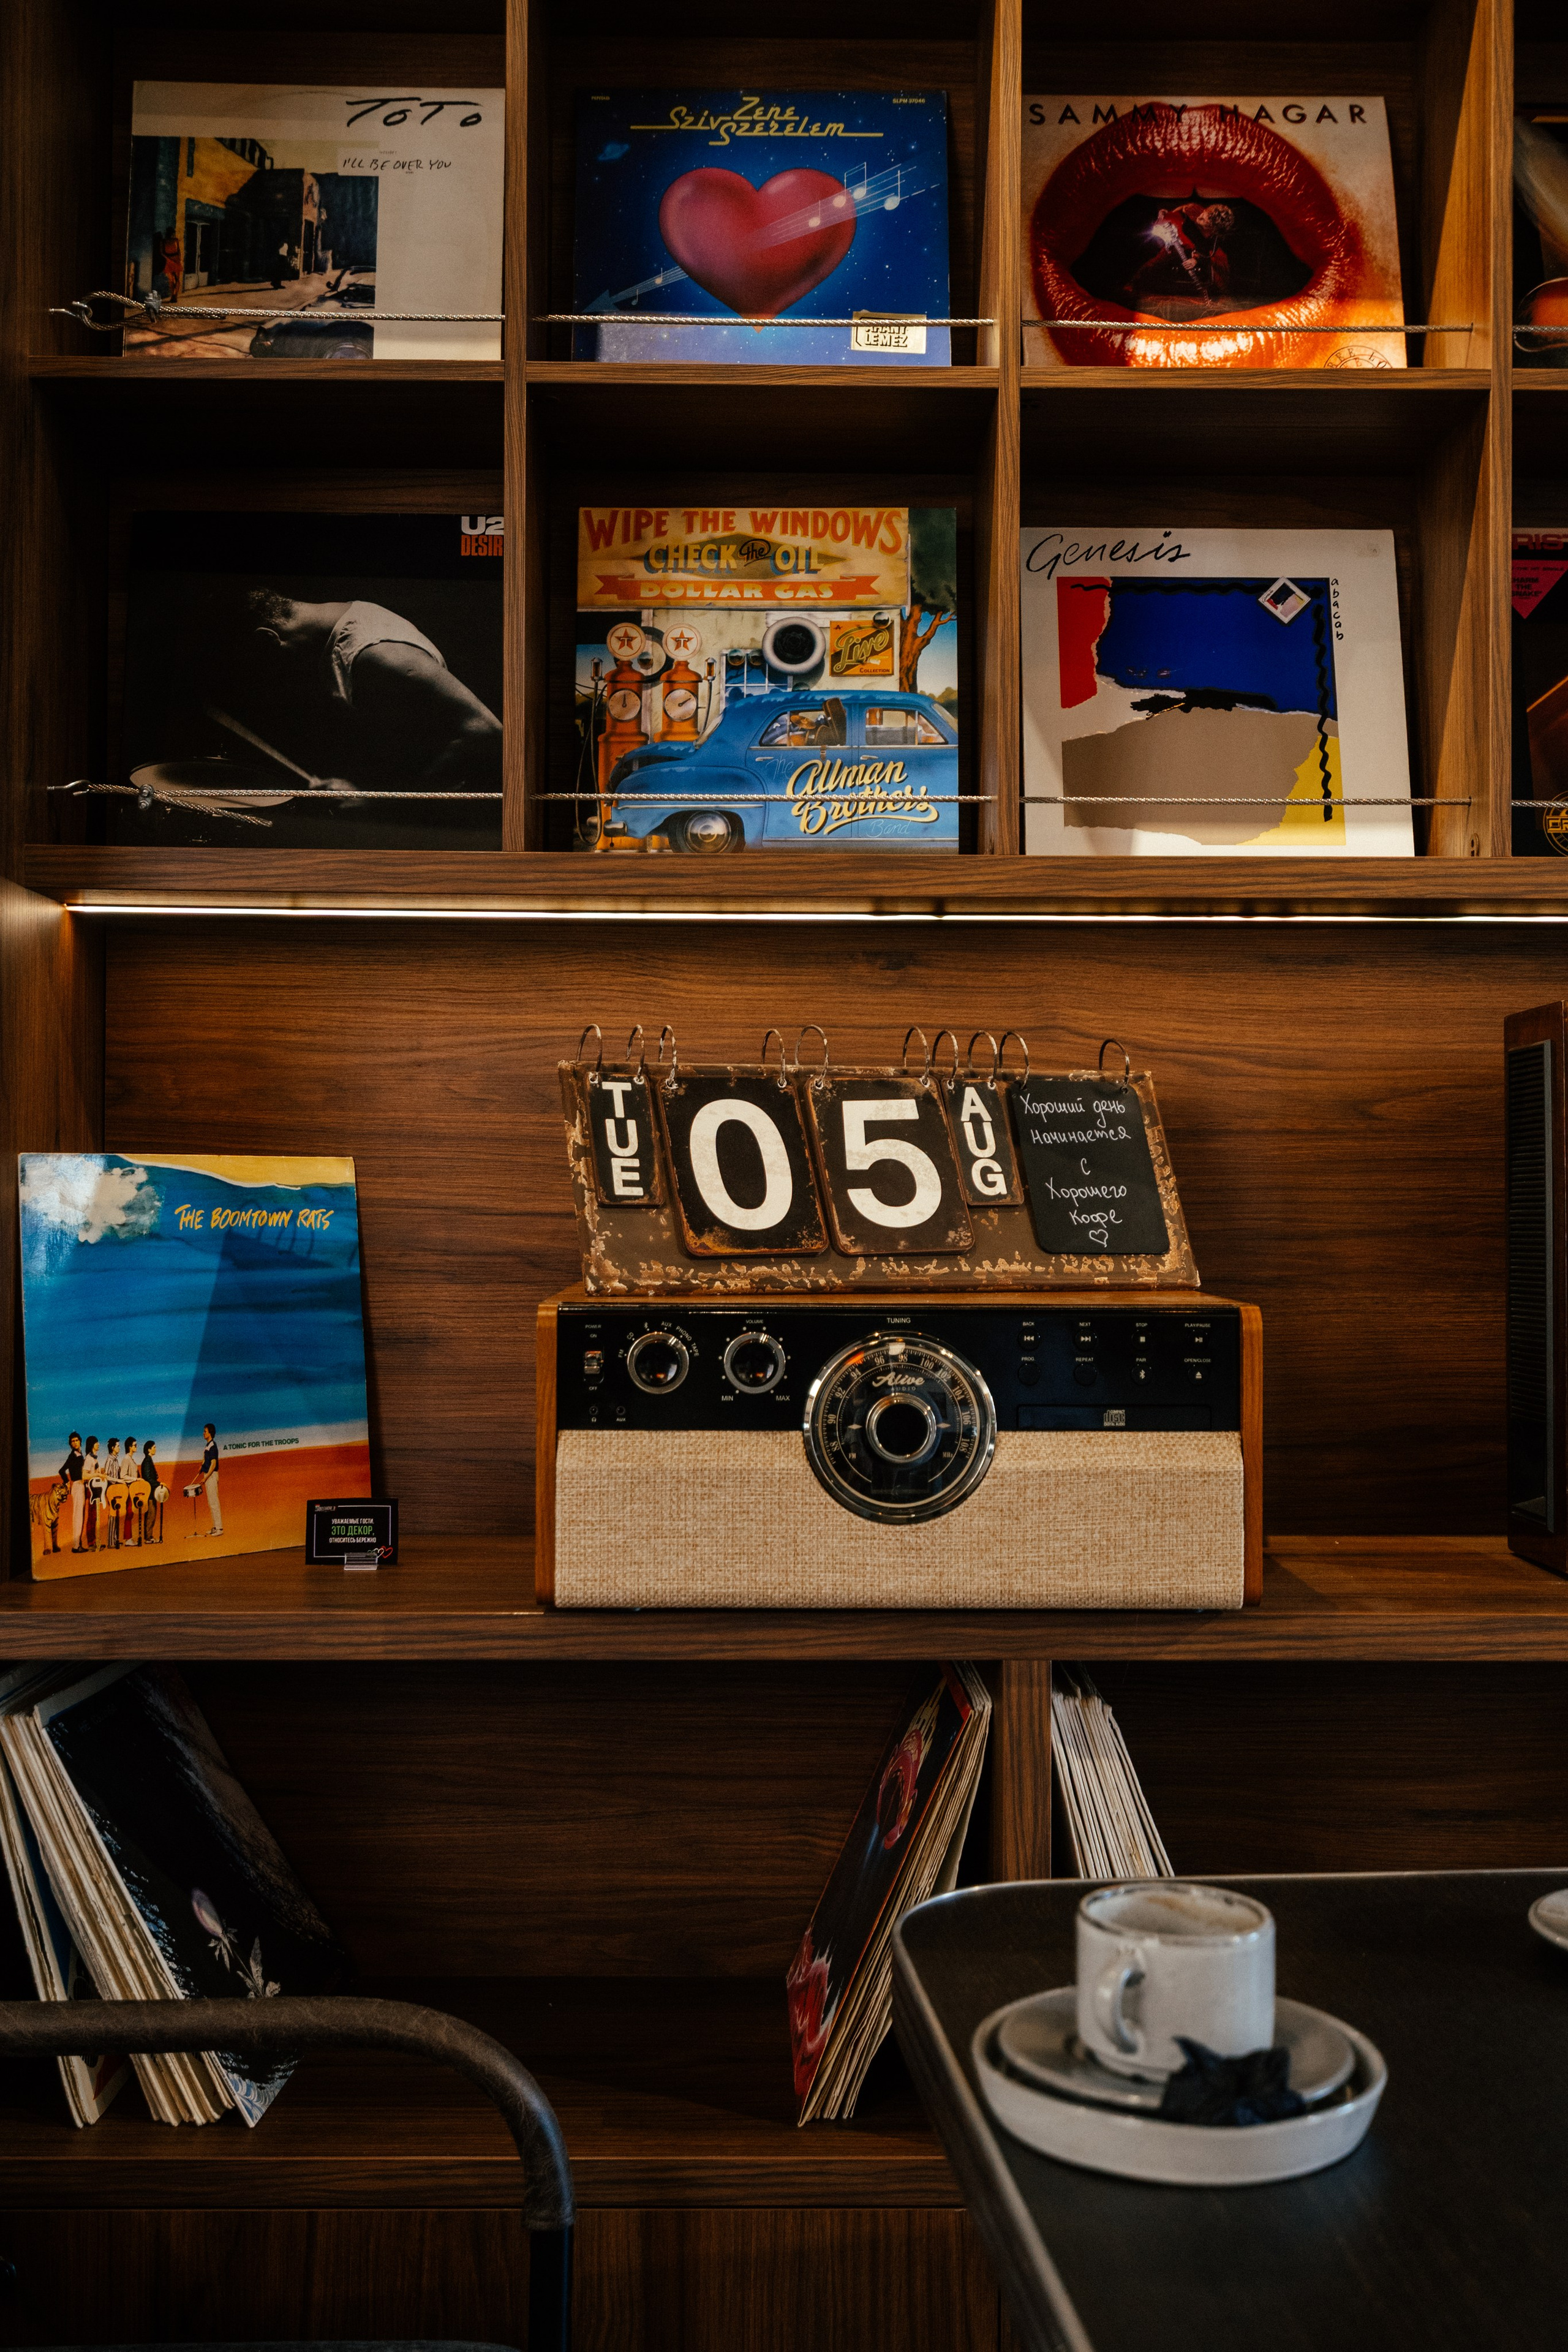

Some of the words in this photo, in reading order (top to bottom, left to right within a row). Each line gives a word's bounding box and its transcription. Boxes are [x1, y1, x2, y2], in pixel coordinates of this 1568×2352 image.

[733, 97, 799, 120] Zene
[1029, 103, 1188, 125] SAMMY
[1219, 104, 1368, 125] HAGAR
[709, 116, 880, 146] Szerelem
[343, 158, 364, 168] I'LL
[370, 159, 390, 170] BE
[393, 159, 423, 170] OVER
[429, 159, 451, 170] YOU
[865, 334, 908, 347] LEMEZ
[461, 516, 504, 535] U2
[582, 510, 669, 551] WIPE
[682, 510, 736, 533] THE
[749, 510, 902, 556] WINDOWS
[1512, 533, 1568, 550] RIS
[645, 543, 737, 573] CHECK
[738, 538, 771, 567] the
[771, 545, 824, 574] OIL
[1026, 530, 1191, 580] Genesis
[639, 582, 763, 598] DOLLAR
[774, 584, 834, 598] GAS
[834, 625, 889, 672] Live
[786, 758, 907, 798] Allman
[1020, 1093, 1085, 1122] Хороший
[1093, 1100, 1126, 1128] день
[601, 1081, 643, 1196] TUE
[961, 1087, 1008, 1196] AUG
[175, 1204, 205, 1231] THE
[211, 1207, 293, 1229] BOOMTOWN
[297, 1208, 334, 1230] RATS
[676, 1325, 692, 1341] PHONO
[618, 1349, 624, 1358] FM
[875, 1355, 885, 1366] 96
[898, 1353, 908, 1362] 98
[920, 1357, 935, 1370] 100
[850, 1368, 862, 1379] 94
[872, 1371, 925, 1387] Alive
[938, 1368, 951, 1382] 102
[835, 1387, 845, 1399] 92
[952, 1385, 965, 1401] 104
[827, 1414, 837, 1424] 90
[962, 1411, 971, 1425] 106
[829, 1441, 840, 1452] 88
[959, 1438, 970, 1453] 108
[331, 1526, 345, 1535] ЭТО
[347, 1525, 375, 1536] ДЕКОР,
